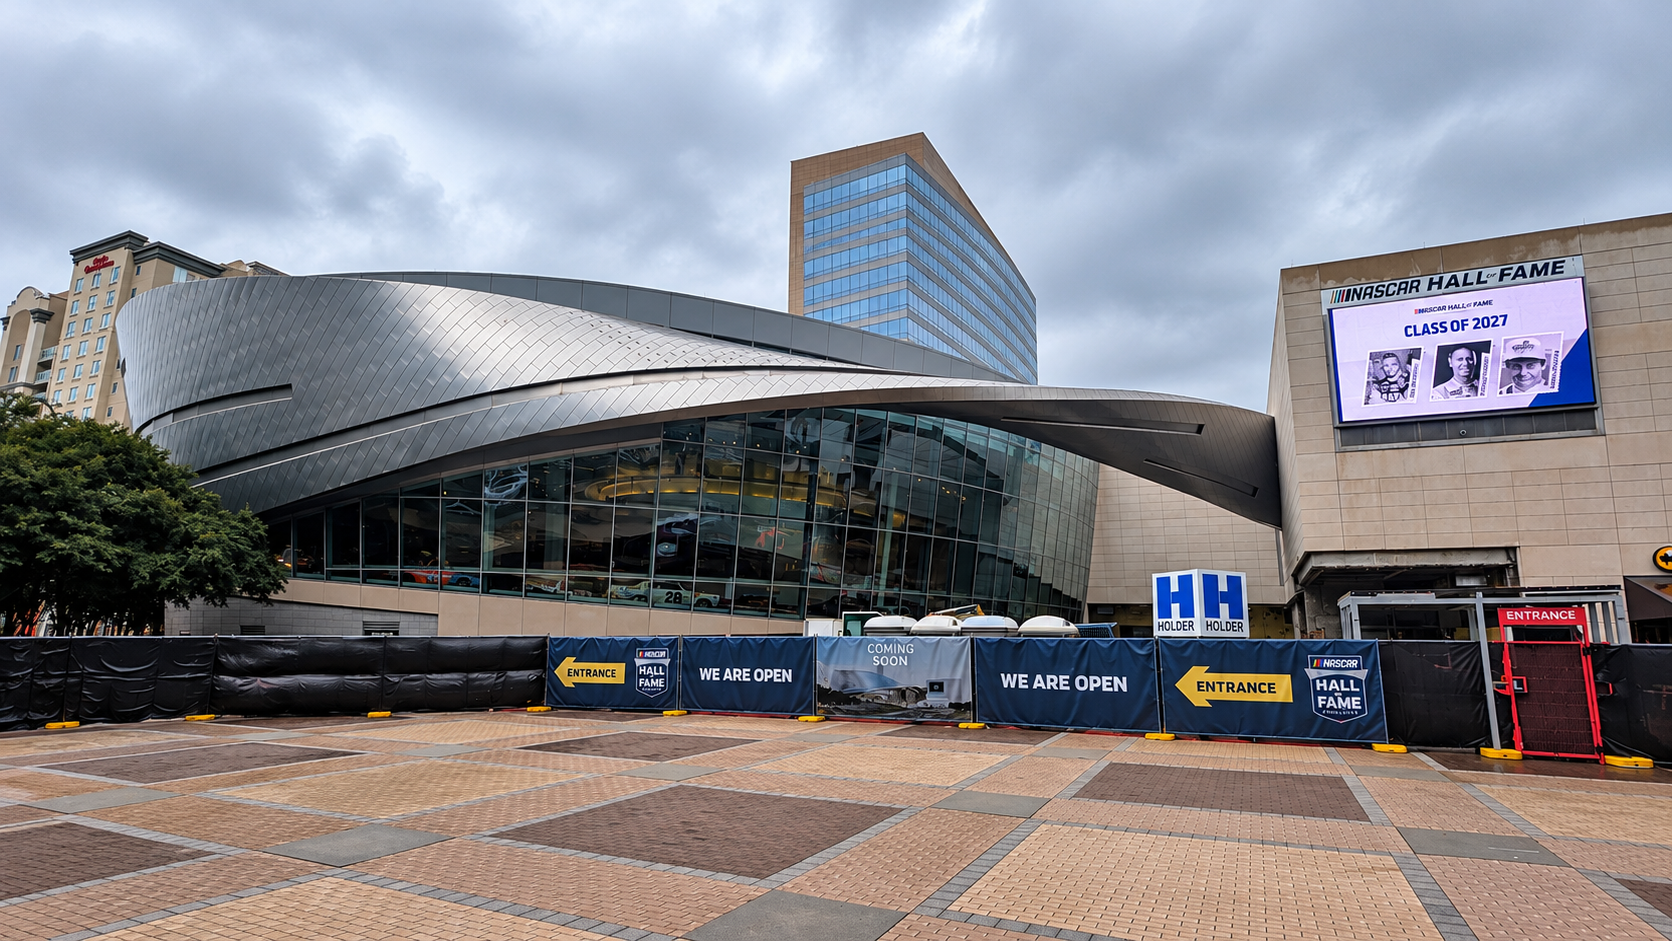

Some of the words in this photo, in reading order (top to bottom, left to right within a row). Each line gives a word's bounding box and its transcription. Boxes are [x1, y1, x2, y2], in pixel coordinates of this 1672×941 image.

[1349, 278, 1420, 302] NASCAR
[1427, 270, 1488, 291] HALL
[1498, 259, 1566, 282] FAME
[1448, 302, 1466, 311] HALL
[1473, 299, 1493, 307] FAME
[1404, 321, 1448, 337] CLASS
[1450, 318, 1469, 332] OF
[1472, 314, 1508, 330] 2027
[1506, 610, 1576, 620] ENTRANCE
[1158, 620, 1195, 632] HOLDER
[1206, 620, 1244, 633] HOLDER
[867, 643, 914, 655] COMING
[872, 655, 908, 666] SOON
[1323, 658, 1358, 668] NASCAR
[567, 668, 616, 679] ENTRANCE
[639, 666, 665, 675] HALL
[699, 667, 720, 681] WE
[723, 667, 751, 682] ARE
[753, 668, 793, 683] OPEN
[639, 678, 665, 687] FAME
[1000, 672, 1028, 689] WE
[1033, 674, 1070, 690] ARE
[1074, 675, 1128, 693] OPEN
[1196, 680, 1277, 694] ENTRANCE
[1316, 679, 1360, 692] HALL
[1317, 696, 1362, 710] FAME
